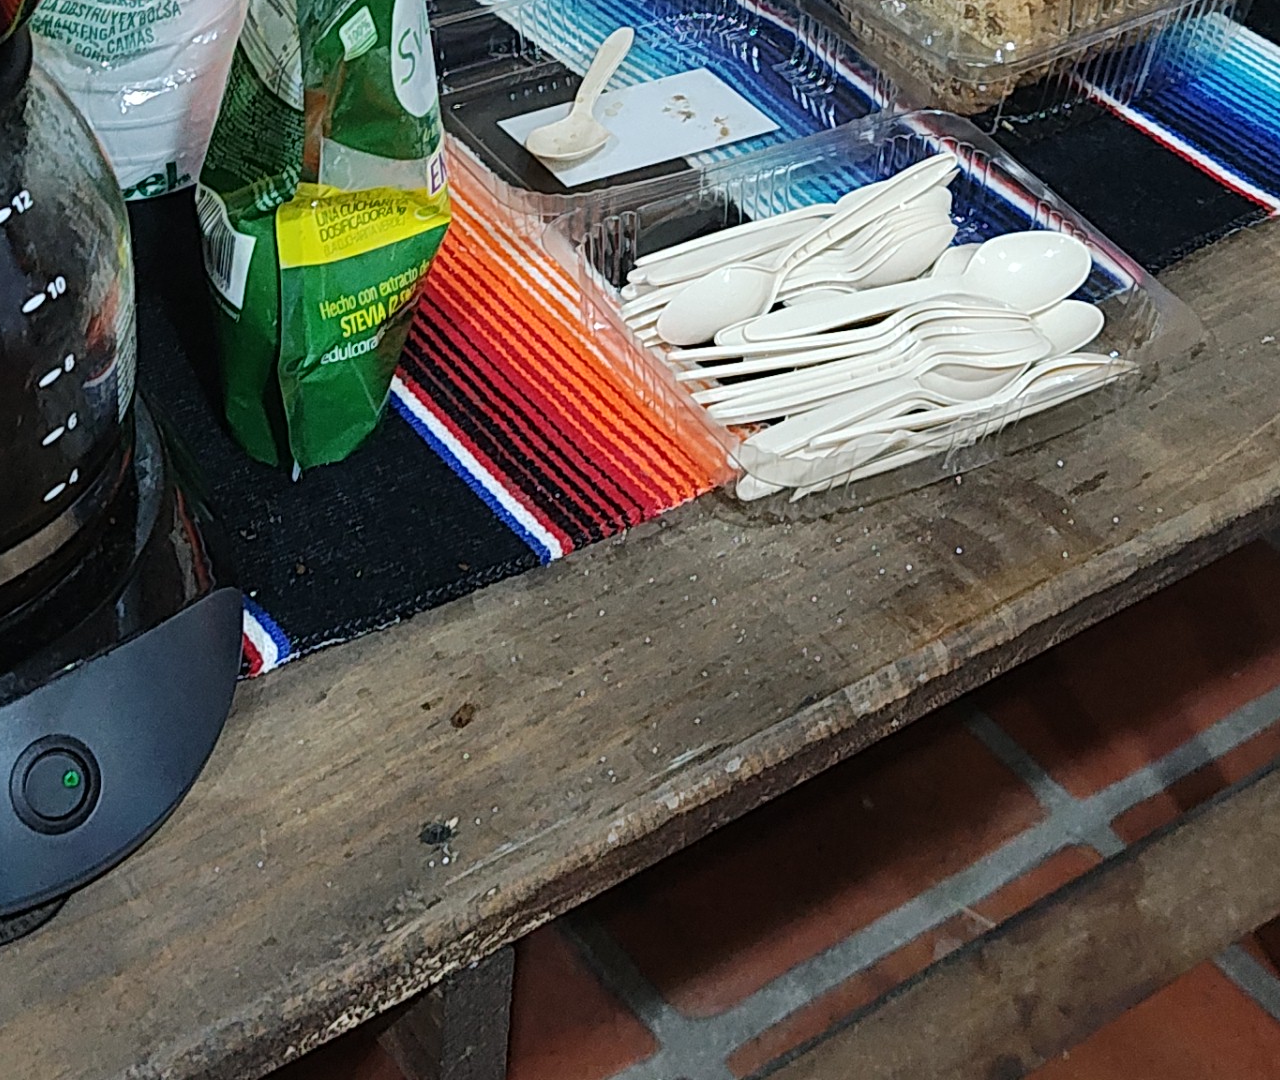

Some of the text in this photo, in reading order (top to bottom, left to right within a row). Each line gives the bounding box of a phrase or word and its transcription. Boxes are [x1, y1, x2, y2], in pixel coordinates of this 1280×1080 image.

[11, 189, 34, 214] 12
[319, 204, 395, 243] DOSIFICADORA
[47, 275, 67, 300] 10
[319, 293, 357, 321] Hecho
[357, 285, 379, 306] con
[378, 266, 419, 296] extracto
[339, 301, 388, 340] STEVIA
[64, 353, 76, 373] 8
[67, 412, 78, 431] 6
[68, 468, 80, 485] 4
